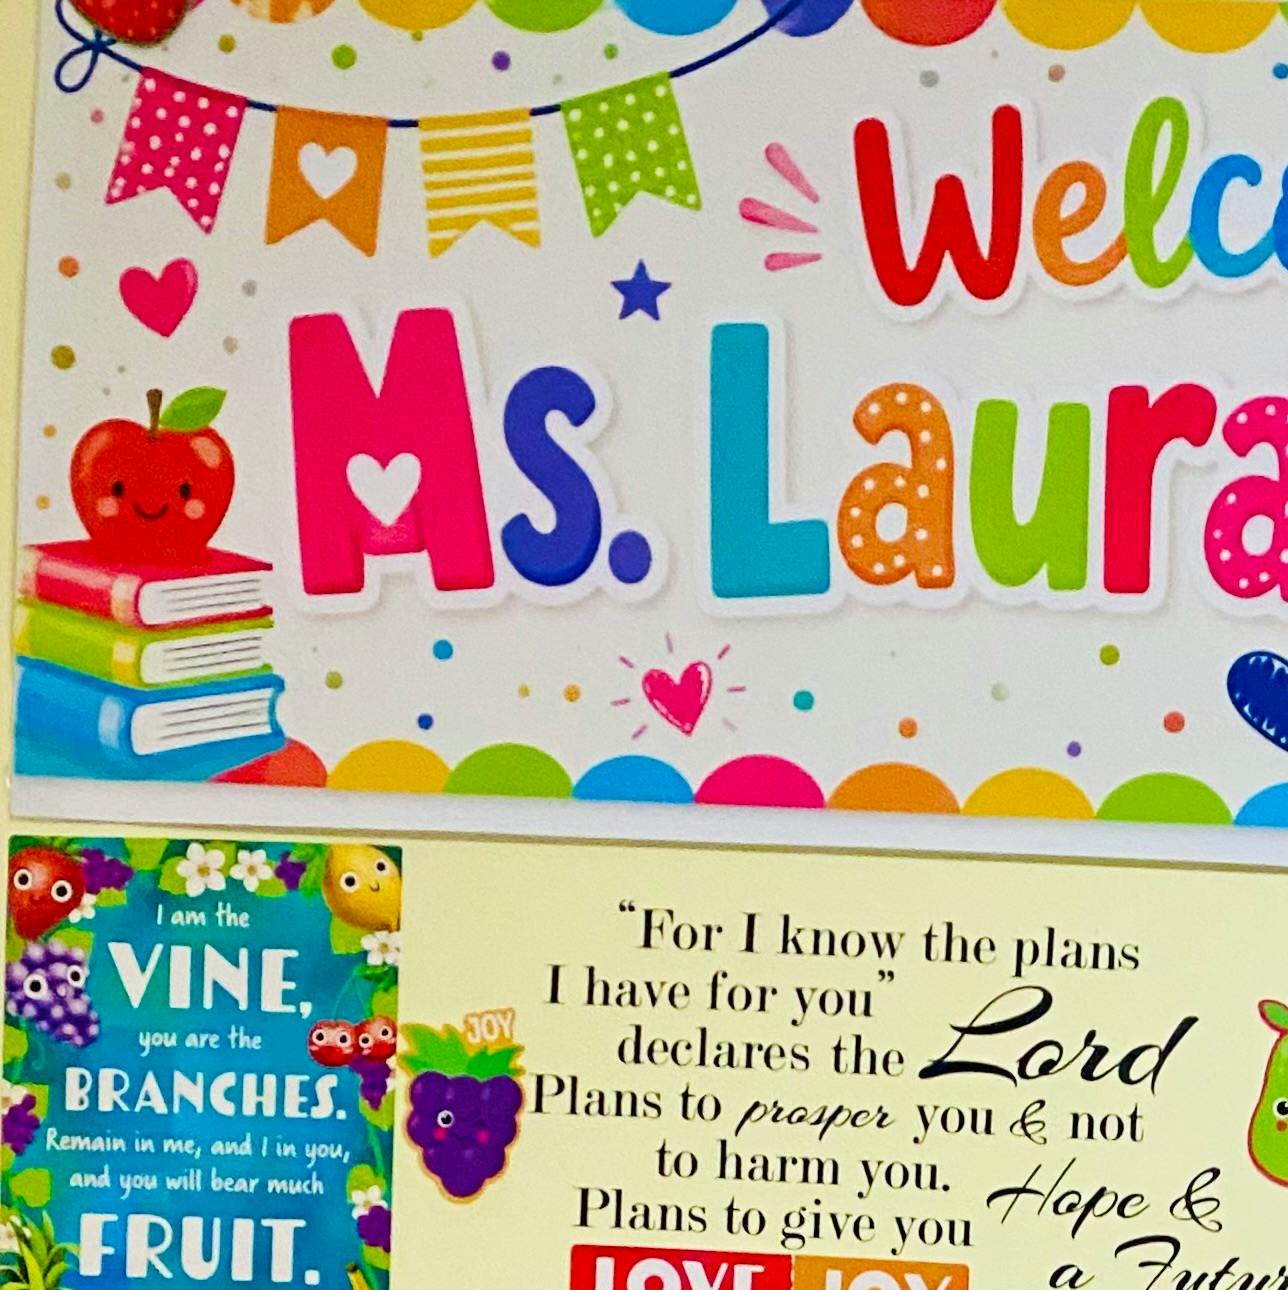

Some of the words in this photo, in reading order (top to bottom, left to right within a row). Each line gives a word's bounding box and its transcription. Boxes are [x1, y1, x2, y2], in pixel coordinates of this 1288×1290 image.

[289, 307, 652, 596] Ms.
[157, 904, 163, 925] I
[171, 911, 206, 925] am
[216, 902, 249, 928] the
[742, 913, 756, 953] I
[781, 914, 904, 959] know
[923, 925, 997, 965] the
[1013, 927, 1139, 978] plans
[108, 942, 312, 1018] VINE,
[549, 965, 560, 1004] I
[586, 966, 690, 1009] have
[710, 971, 777, 1012] for
[139, 1032, 177, 1057] you
[185, 1033, 219, 1048] are
[228, 1025, 261, 1050] the
[466, 1013, 514, 1043] JOY
[618, 1024, 809, 1070] declares
[833, 1034, 904, 1075] the
[918, 986, 1199, 1095] Lord
[65, 1067, 346, 1120] BRANCHES.
[534, 1074, 661, 1117] Plans
[681, 1085, 721, 1121] to
[735, 1100, 892, 1141] prosper
[913, 1105, 992, 1144] you
[1009, 1099, 1047, 1145] &
[1071, 1104, 1138, 1142] not
[46, 1127, 126, 1151] Remain
[134, 1133, 154, 1155] in
[163, 1139, 201, 1159] me,
[211, 1133, 252, 1155] and
[261, 1137, 268, 1157] I
[276, 1137, 297, 1158] in
[305, 1142, 350, 1164] you,
[657, 1140, 698, 1177] to
[718, 1139, 839, 1185] harm
[856, 1150, 951, 1196] you.
[69, 1168, 112, 1190] and
[120, 1174, 158, 1199] you
[166, 1168, 201, 1191] will
[211, 1173, 260, 1193] bear
[267, 1175, 324, 1196] much
[986, 1158, 1149, 1239] Hope
[1169, 1167, 1223, 1232] &
[78, 1213, 320, 1285] FRUIT.
[578, 1188, 707, 1232] Plans
[726, 1198, 766, 1235] to
[780, 1198, 875, 1249] give
[891, 1216, 972, 1256] you
[1049, 1264, 1094, 1289] a
